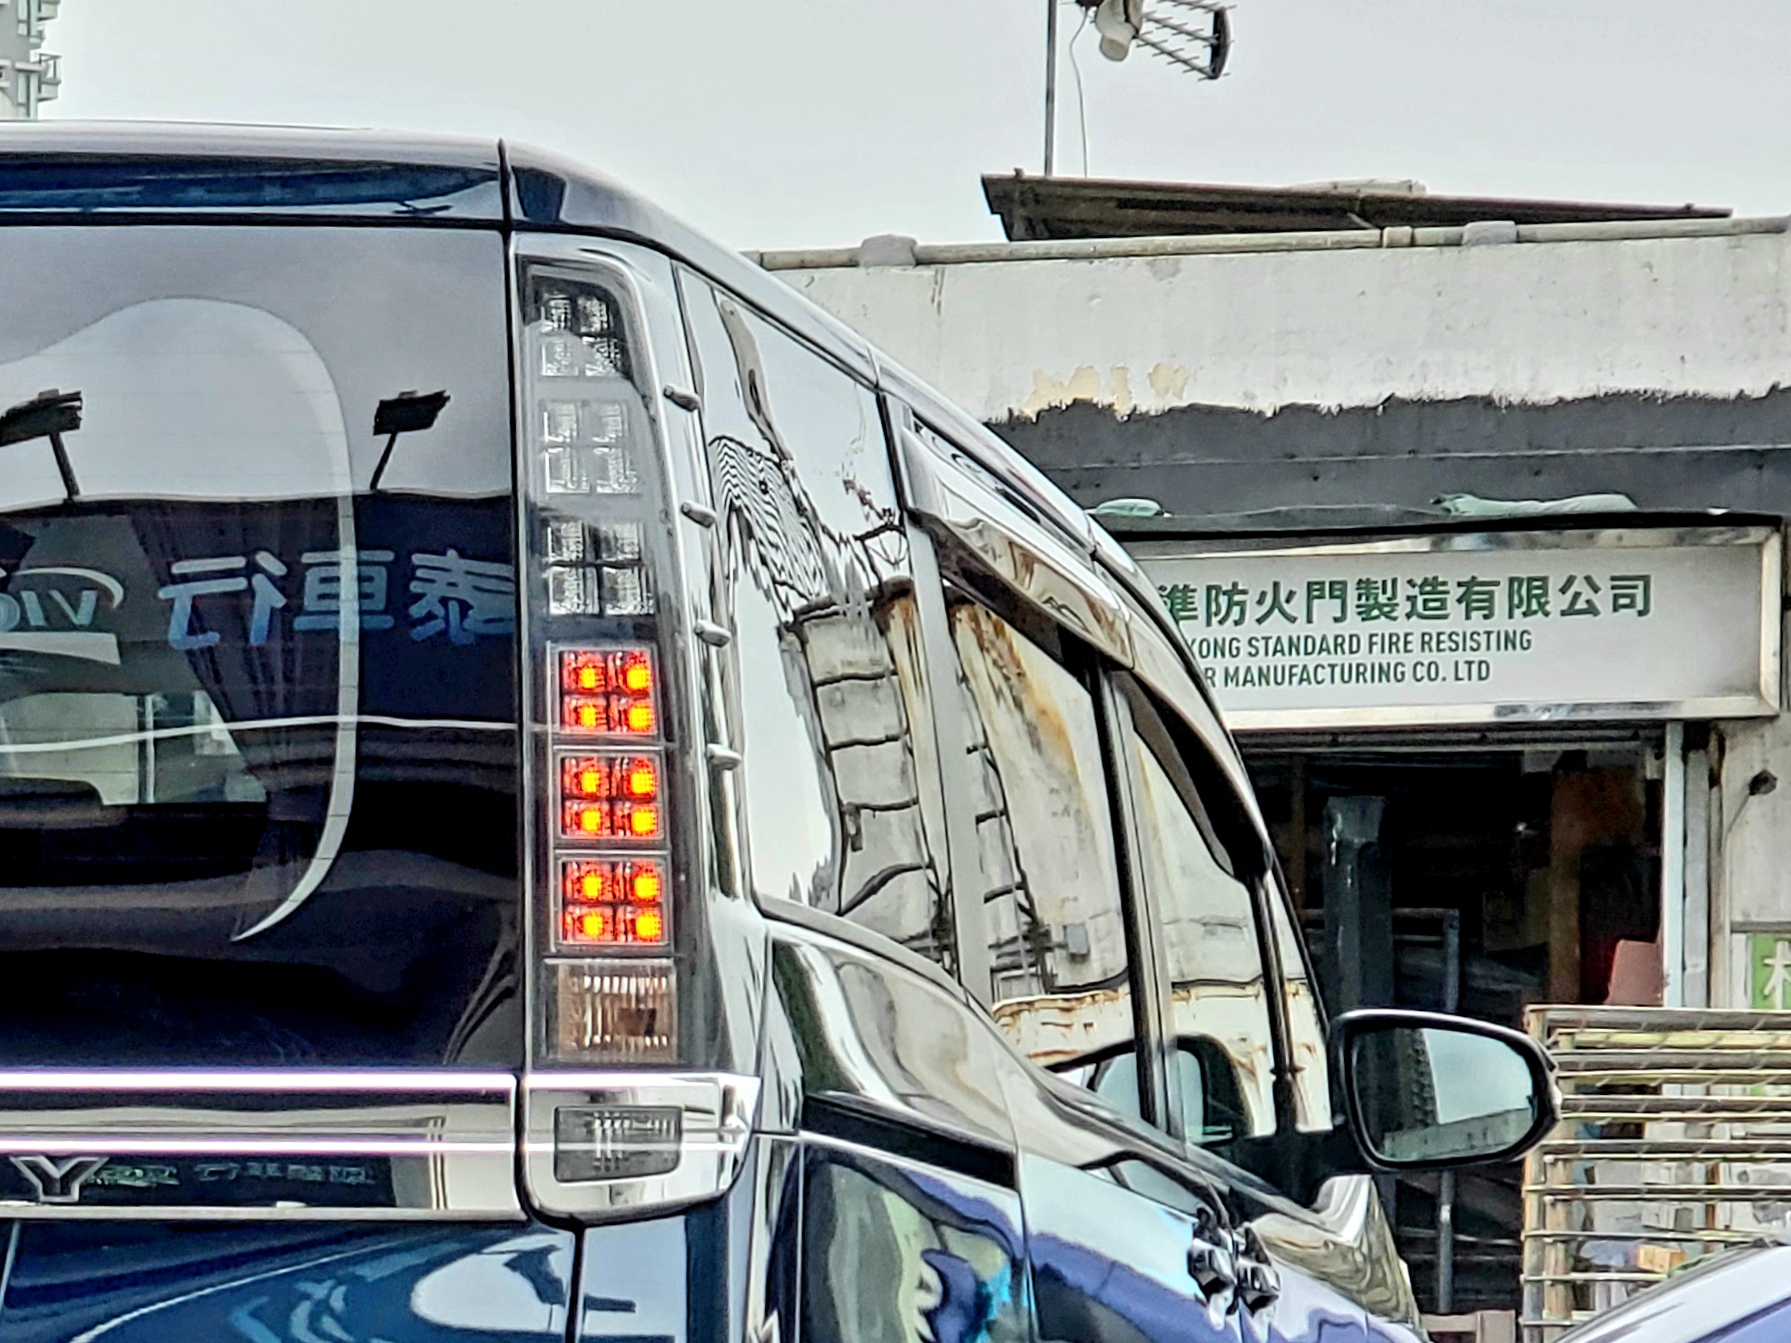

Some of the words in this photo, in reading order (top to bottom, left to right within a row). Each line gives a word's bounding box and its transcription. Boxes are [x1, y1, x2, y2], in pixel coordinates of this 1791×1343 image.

[1247, 633, 1361, 658] STANDARD
[1368, 632, 1414, 654] FIRE
[1421, 629, 1532, 653] RESISTING
[1224, 662, 1406, 688] MANUFACTURING
[1412, 660, 1447, 683] CO.
[1454, 660, 1490, 682] LTD
